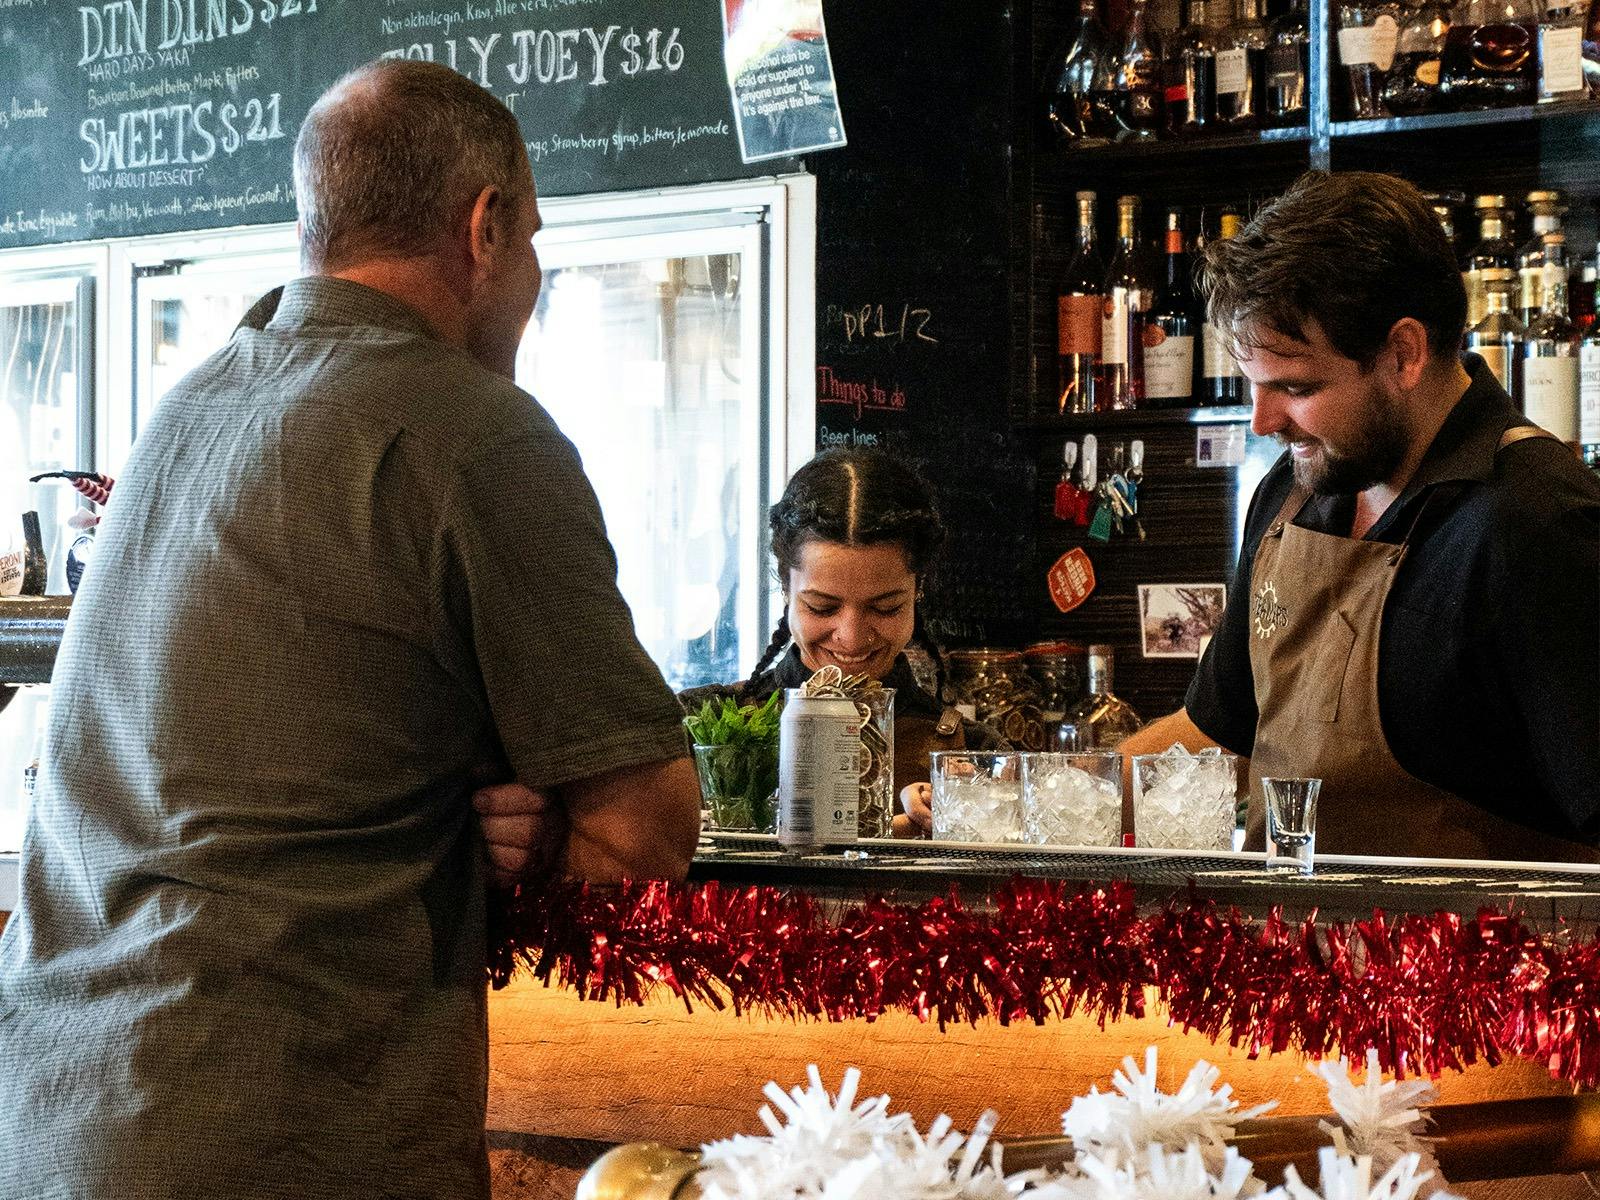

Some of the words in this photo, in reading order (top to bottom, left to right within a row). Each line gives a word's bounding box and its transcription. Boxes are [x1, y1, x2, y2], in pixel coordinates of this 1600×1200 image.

[78, 0, 147, 66] DIN
[506, 25, 621, 86] JOEY
[620, 27, 685, 79] $16
[781, 52, 798, 64] can
[799, 50, 811, 61] be
[736, 75, 757, 88] sold
[757, 75, 769, 84] or
[768, 65, 805, 82] supplied
[805, 63, 815, 75] to
[740, 88, 772, 104] anyone
[773, 84, 798, 97] under
[798, 79, 812, 91] 18.
[742, 105, 756, 117] It's
[757, 99, 788, 115] against
[789, 95, 804, 108] the
[804, 92, 822, 105] law.
[80, 100, 216, 174] SWEETS
[220, 92, 287, 158] $21
[550, 132, 609, 155] Strawberry
[676, 119, 730, 142] lemonade
[114, 171, 146, 189] ABOUT
[815, 365, 869, 421] Things
[871, 378, 887, 404] to
[820, 425, 850, 445] Beer
[852, 427, 878, 447] lines
